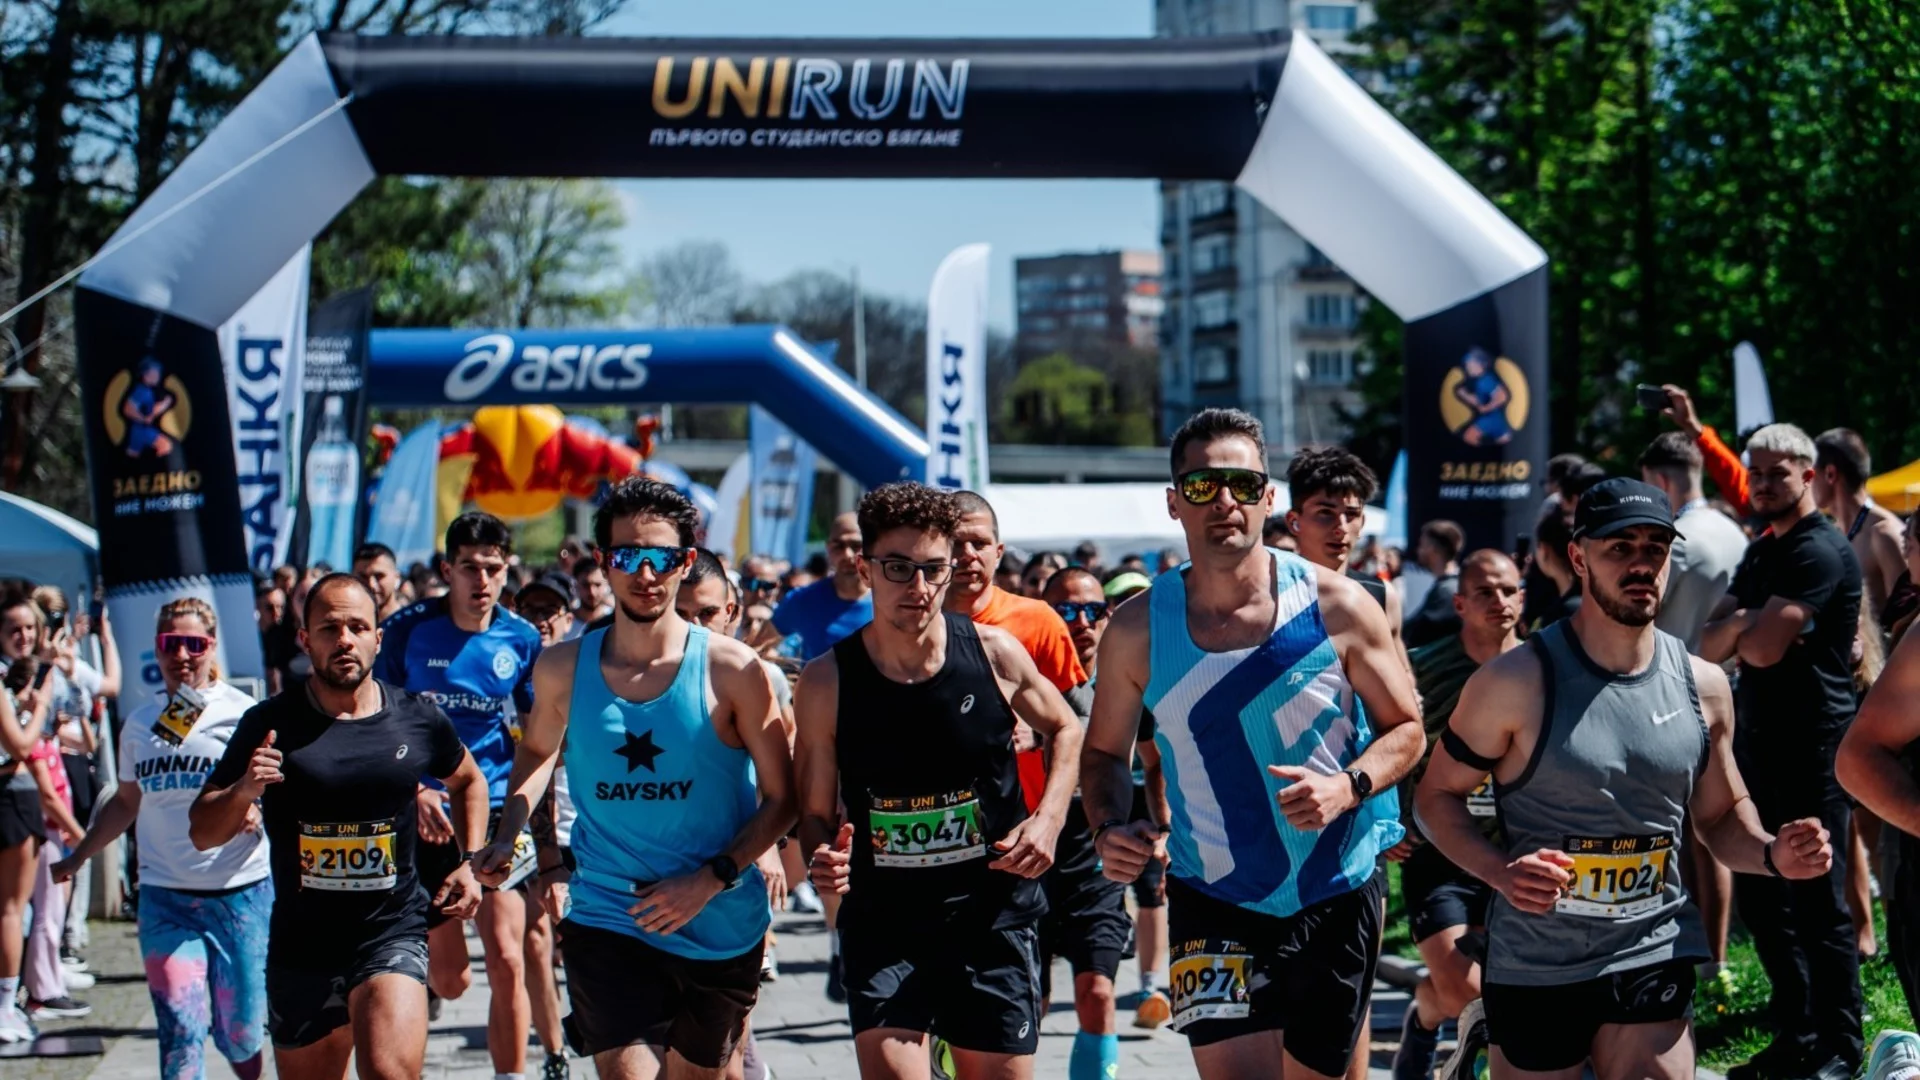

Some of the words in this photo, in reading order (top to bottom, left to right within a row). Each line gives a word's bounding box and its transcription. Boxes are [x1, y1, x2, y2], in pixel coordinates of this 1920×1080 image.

[650, 128, 746, 146] ПЪРВОТО
[750, 128, 884, 147] СТУДЕНТСКО
[886, 128, 963, 147] БЯГАНЕ
[1441, 460, 1531, 482] ЗАЕДНО
[113, 470, 202, 498] ЗАЕДНО
[1619, 494, 1652, 504] KIPRUN
[427, 658, 449, 668] JAKO
[595, 780, 694, 801] SAYSKY
[942, 791, 958, 805] 14
[910, 796, 935, 808] UNI
[337, 824, 359, 834] UNI
[891, 816, 967, 846] 3047
[1612, 838, 1637, 850] UNI
[320, 847, 384, 870] 2109
[1590, 864, 1652, 893] 1102
[1184, 939, 1207, 952] UNI
[1175, 967, 1236, 1002] 2097
